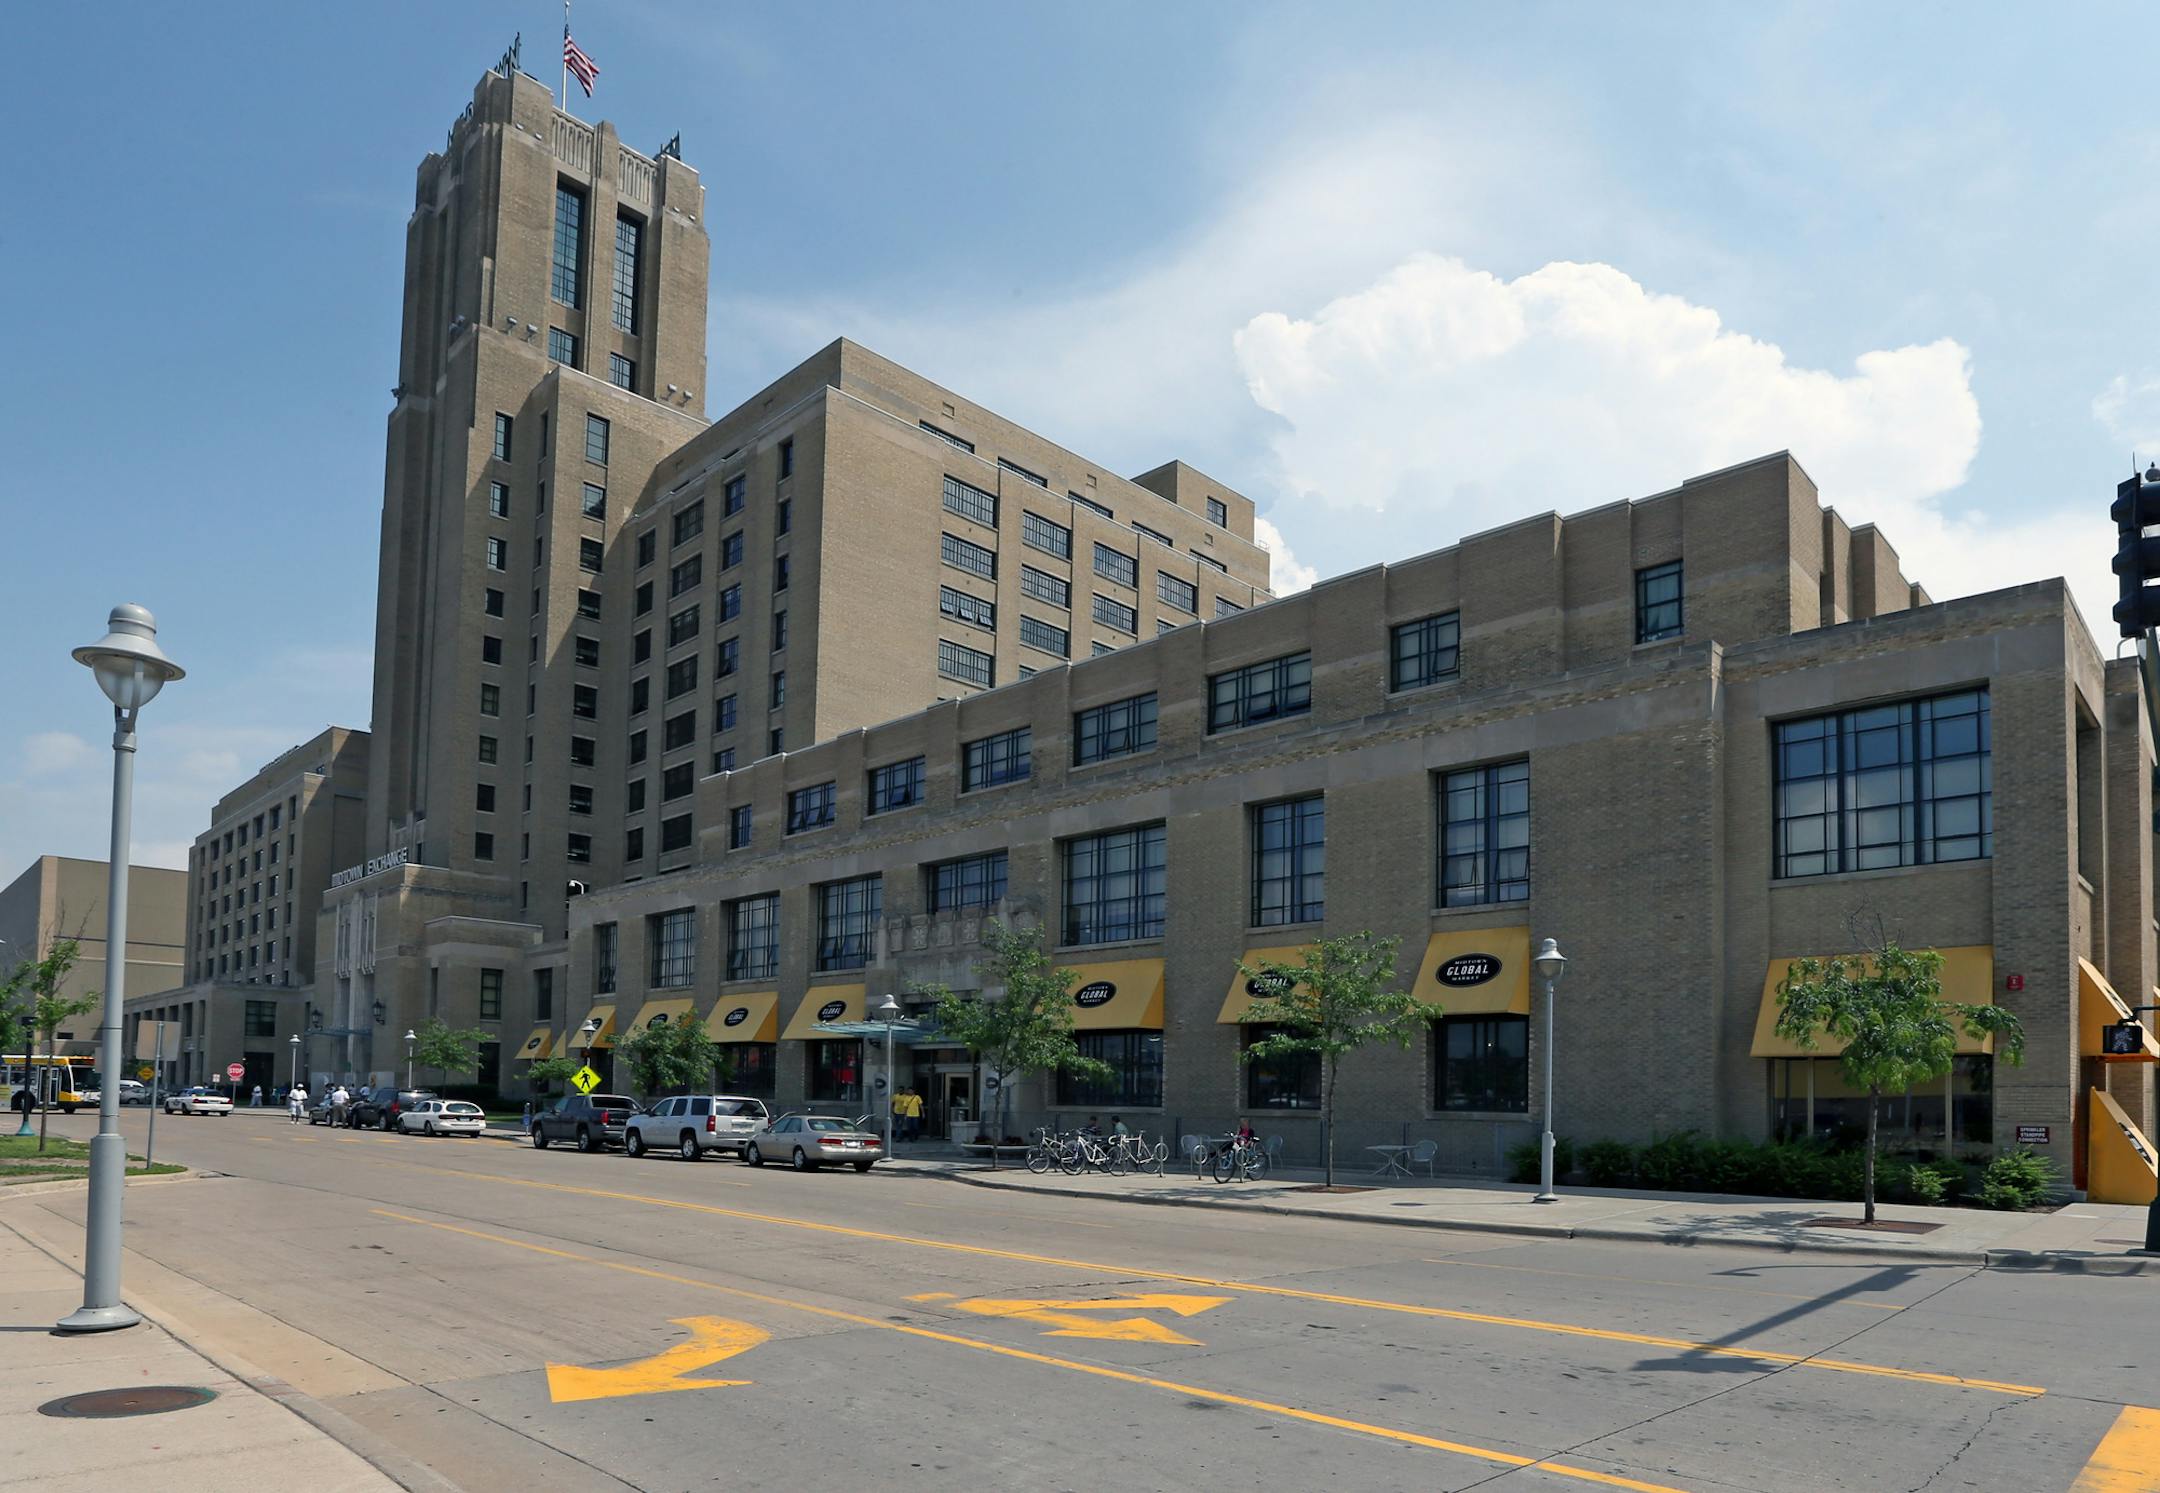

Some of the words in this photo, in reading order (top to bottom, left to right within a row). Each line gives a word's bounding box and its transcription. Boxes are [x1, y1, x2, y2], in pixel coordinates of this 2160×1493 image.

[367, 846, 407, 875] EXCHANGE
[1446, 964, 1489, 976] GLOBAL
[1080, 990, 1108, 999] GLOBAL
